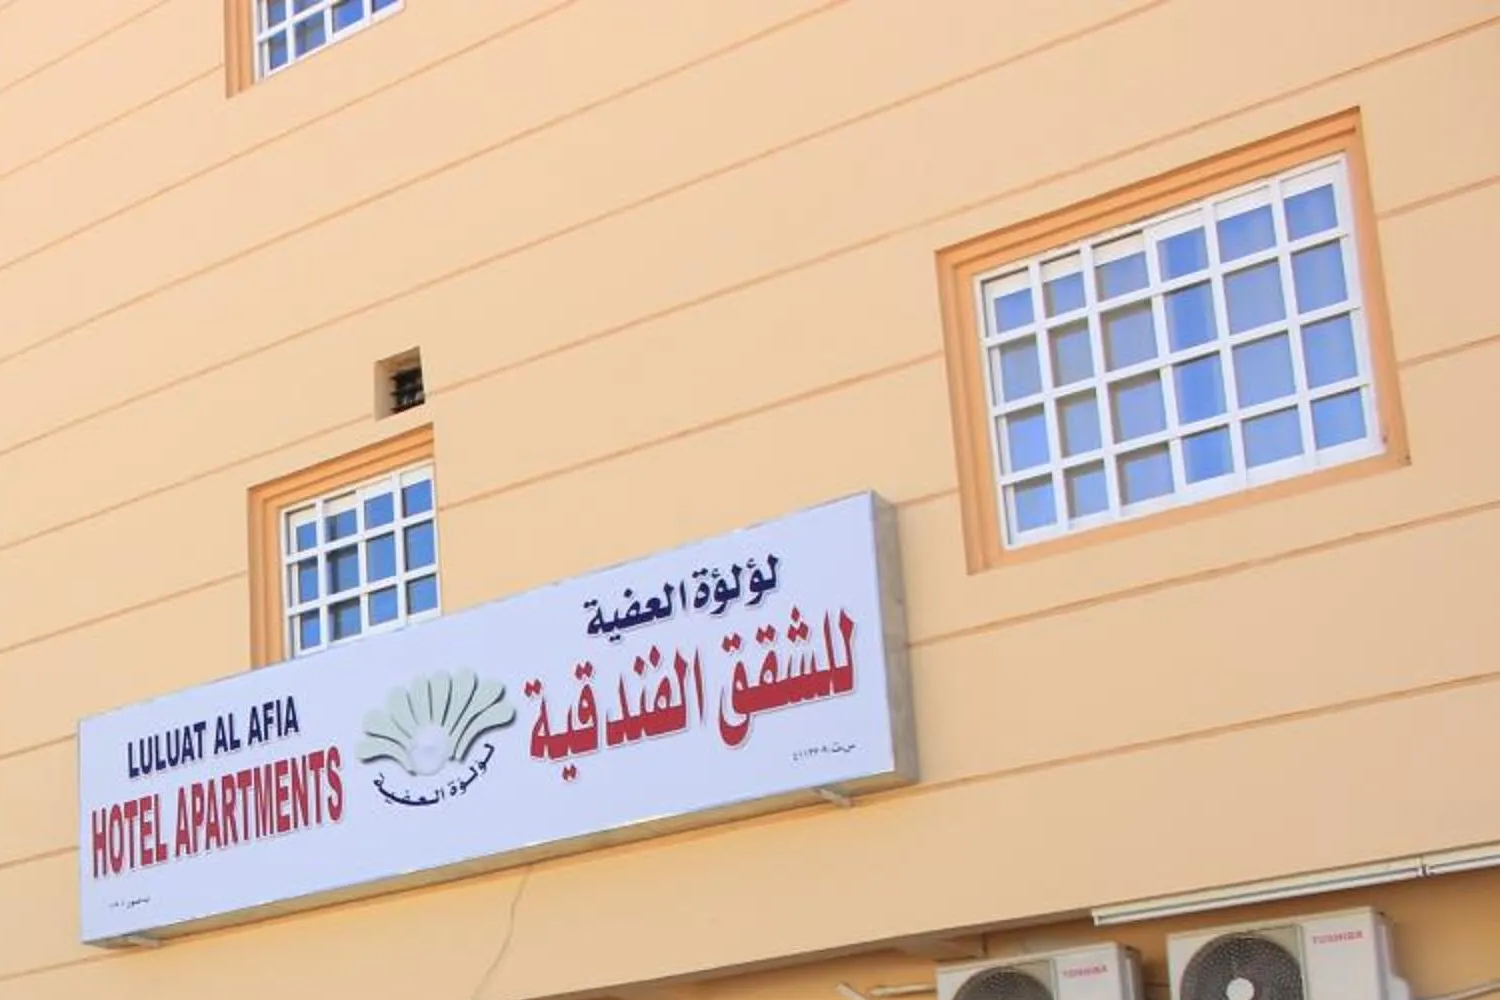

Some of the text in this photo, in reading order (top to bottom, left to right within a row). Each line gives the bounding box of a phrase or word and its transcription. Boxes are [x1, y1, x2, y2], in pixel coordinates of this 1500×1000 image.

[583, 553, 779, 643] لؤلؤة العفية
[524, 605, 855, 781] للشقق الفندقية
[128, 695, 299, 778] LULUAT AL AFIA
[92, 745, 343, 879] HOTEL APARTMENTS
[1062, 964, 1108, 978] TOSHIBA
[1312, 930, 1363, 945] TOSHIBA
